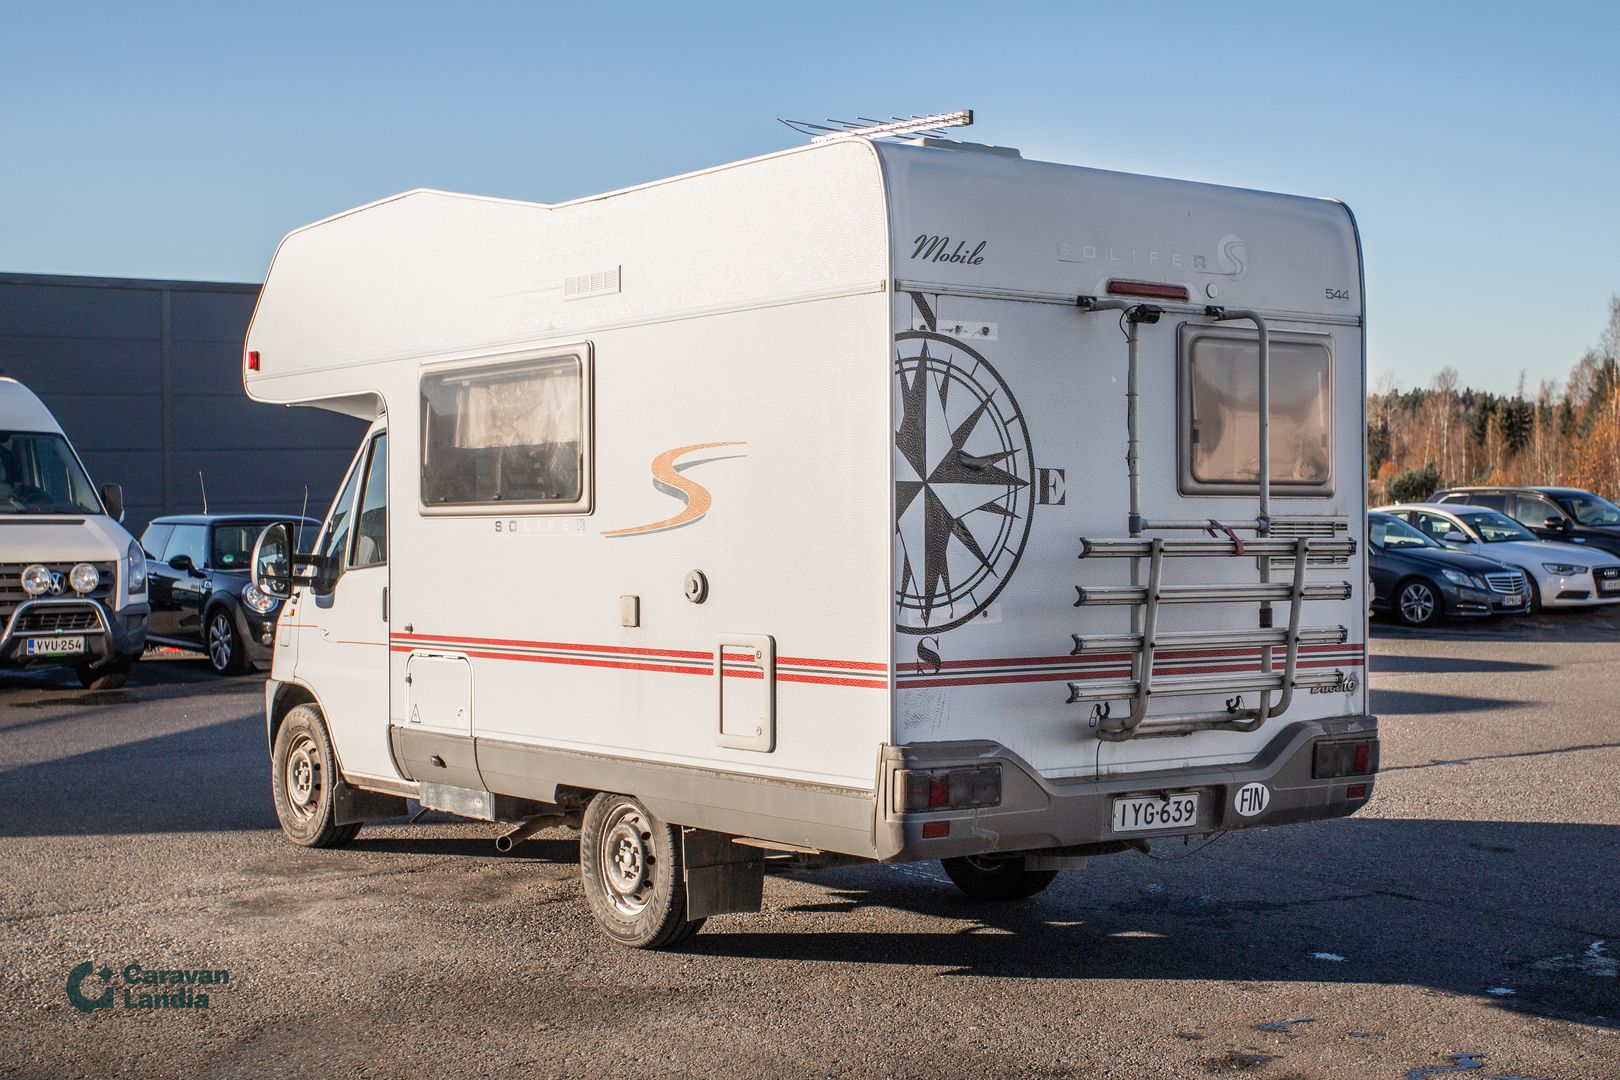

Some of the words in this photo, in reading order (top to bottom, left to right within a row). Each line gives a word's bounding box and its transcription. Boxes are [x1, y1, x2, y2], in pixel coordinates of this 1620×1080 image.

[911, 234, 987, 265] Mobile
[1056, 240, 1206, 269] SOLIFER
[1325, 288, 1349, 300] 544
[1035, 468, 1066, 506] E
[916, 636, 941, 676] S
[1121, 799, 1195, 827] IYG-639
[1239, 786, 1265, 813] FIN
